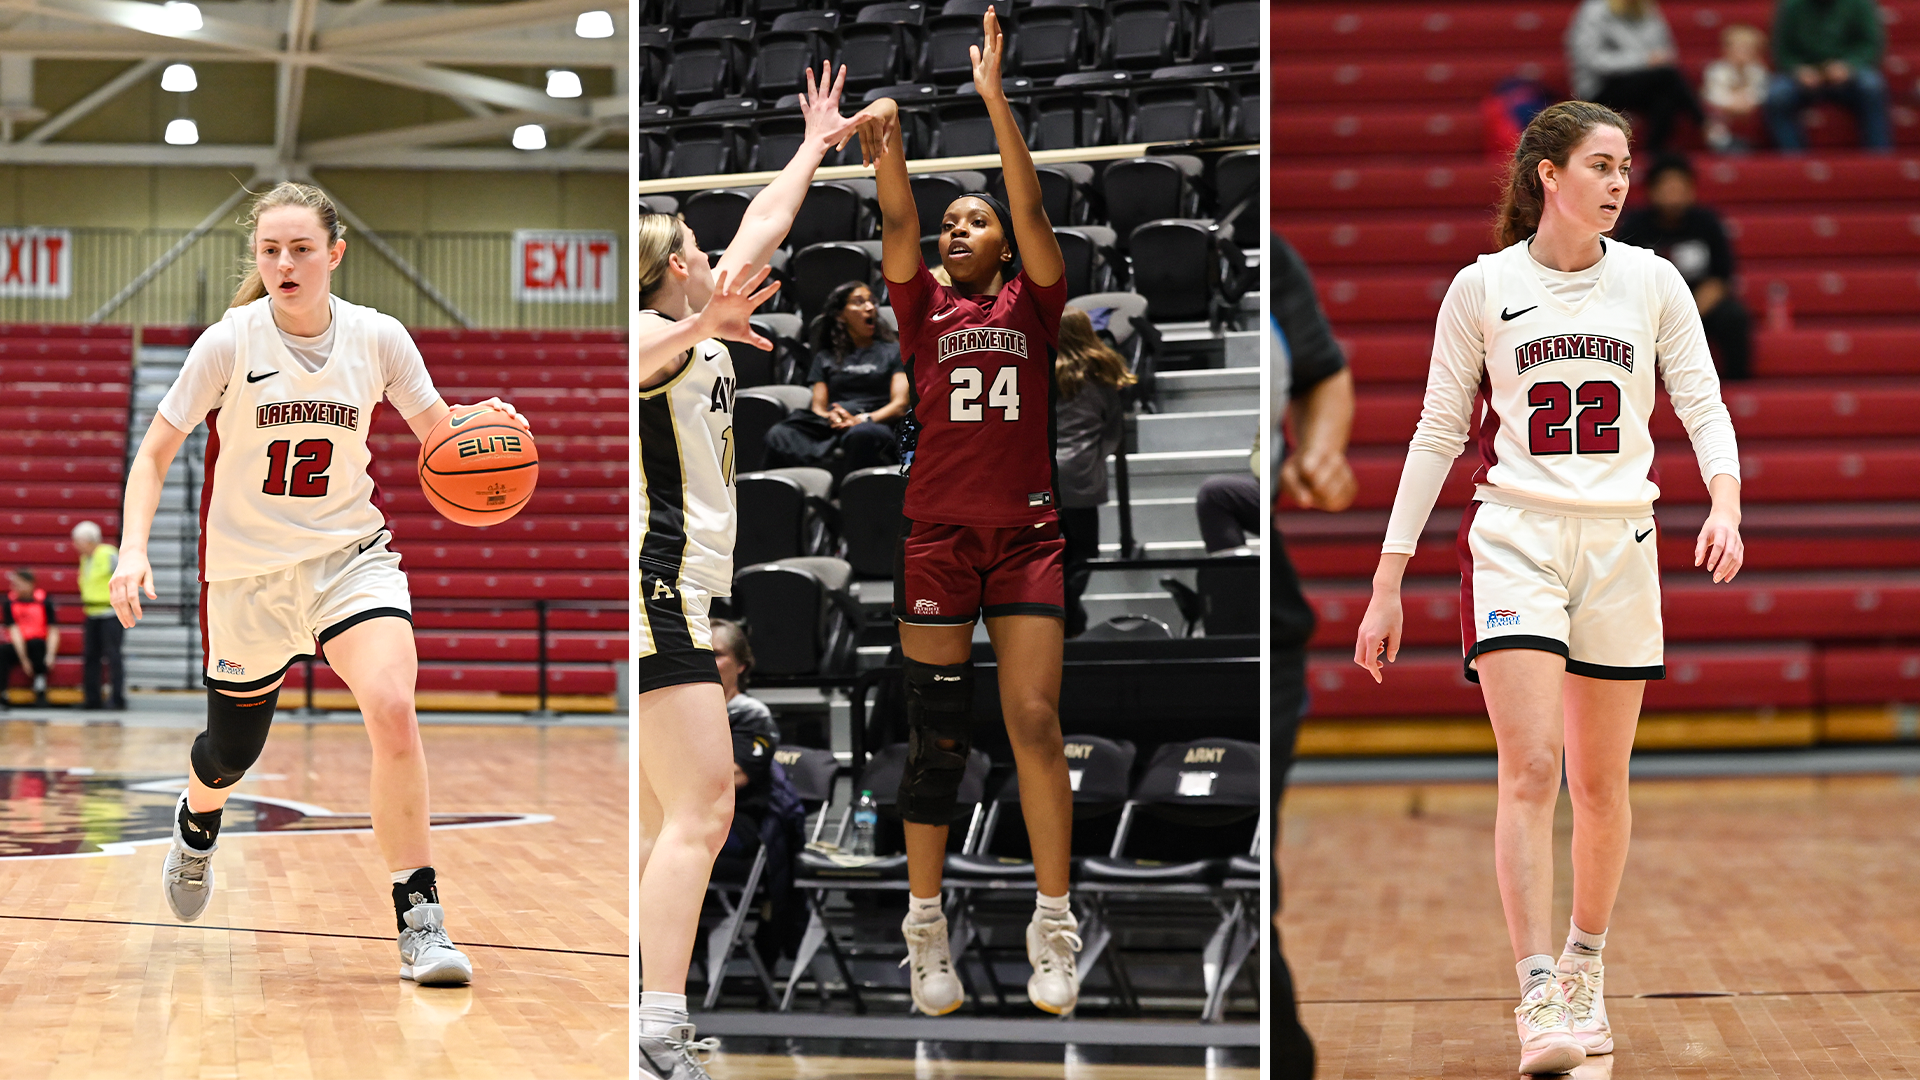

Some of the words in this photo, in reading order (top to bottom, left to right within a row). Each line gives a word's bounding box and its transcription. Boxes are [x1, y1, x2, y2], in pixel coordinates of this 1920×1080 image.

[0, 236, 63, 285] XIT
[525, 240, 610, 289] EXIT
[937, 328, 1028, 363] LAFAYETTE
[1515, 334, 1633, 375] LAFAYETTE
[949, 366, 1020, 422] 24
[257, 401, 359, 431] LAFAYETTE
[1528, 381, 1621, 455] 22
[457, 435, 522, 458] ELITE
[262, 438, 333, 497] 12
[651, 577, 675, 601] A
[1487, 620, 1520, 629] LEAGUE
[1063, 743, 1094, 759] RMY
[1183, 747, 1227, 764] ARMY
